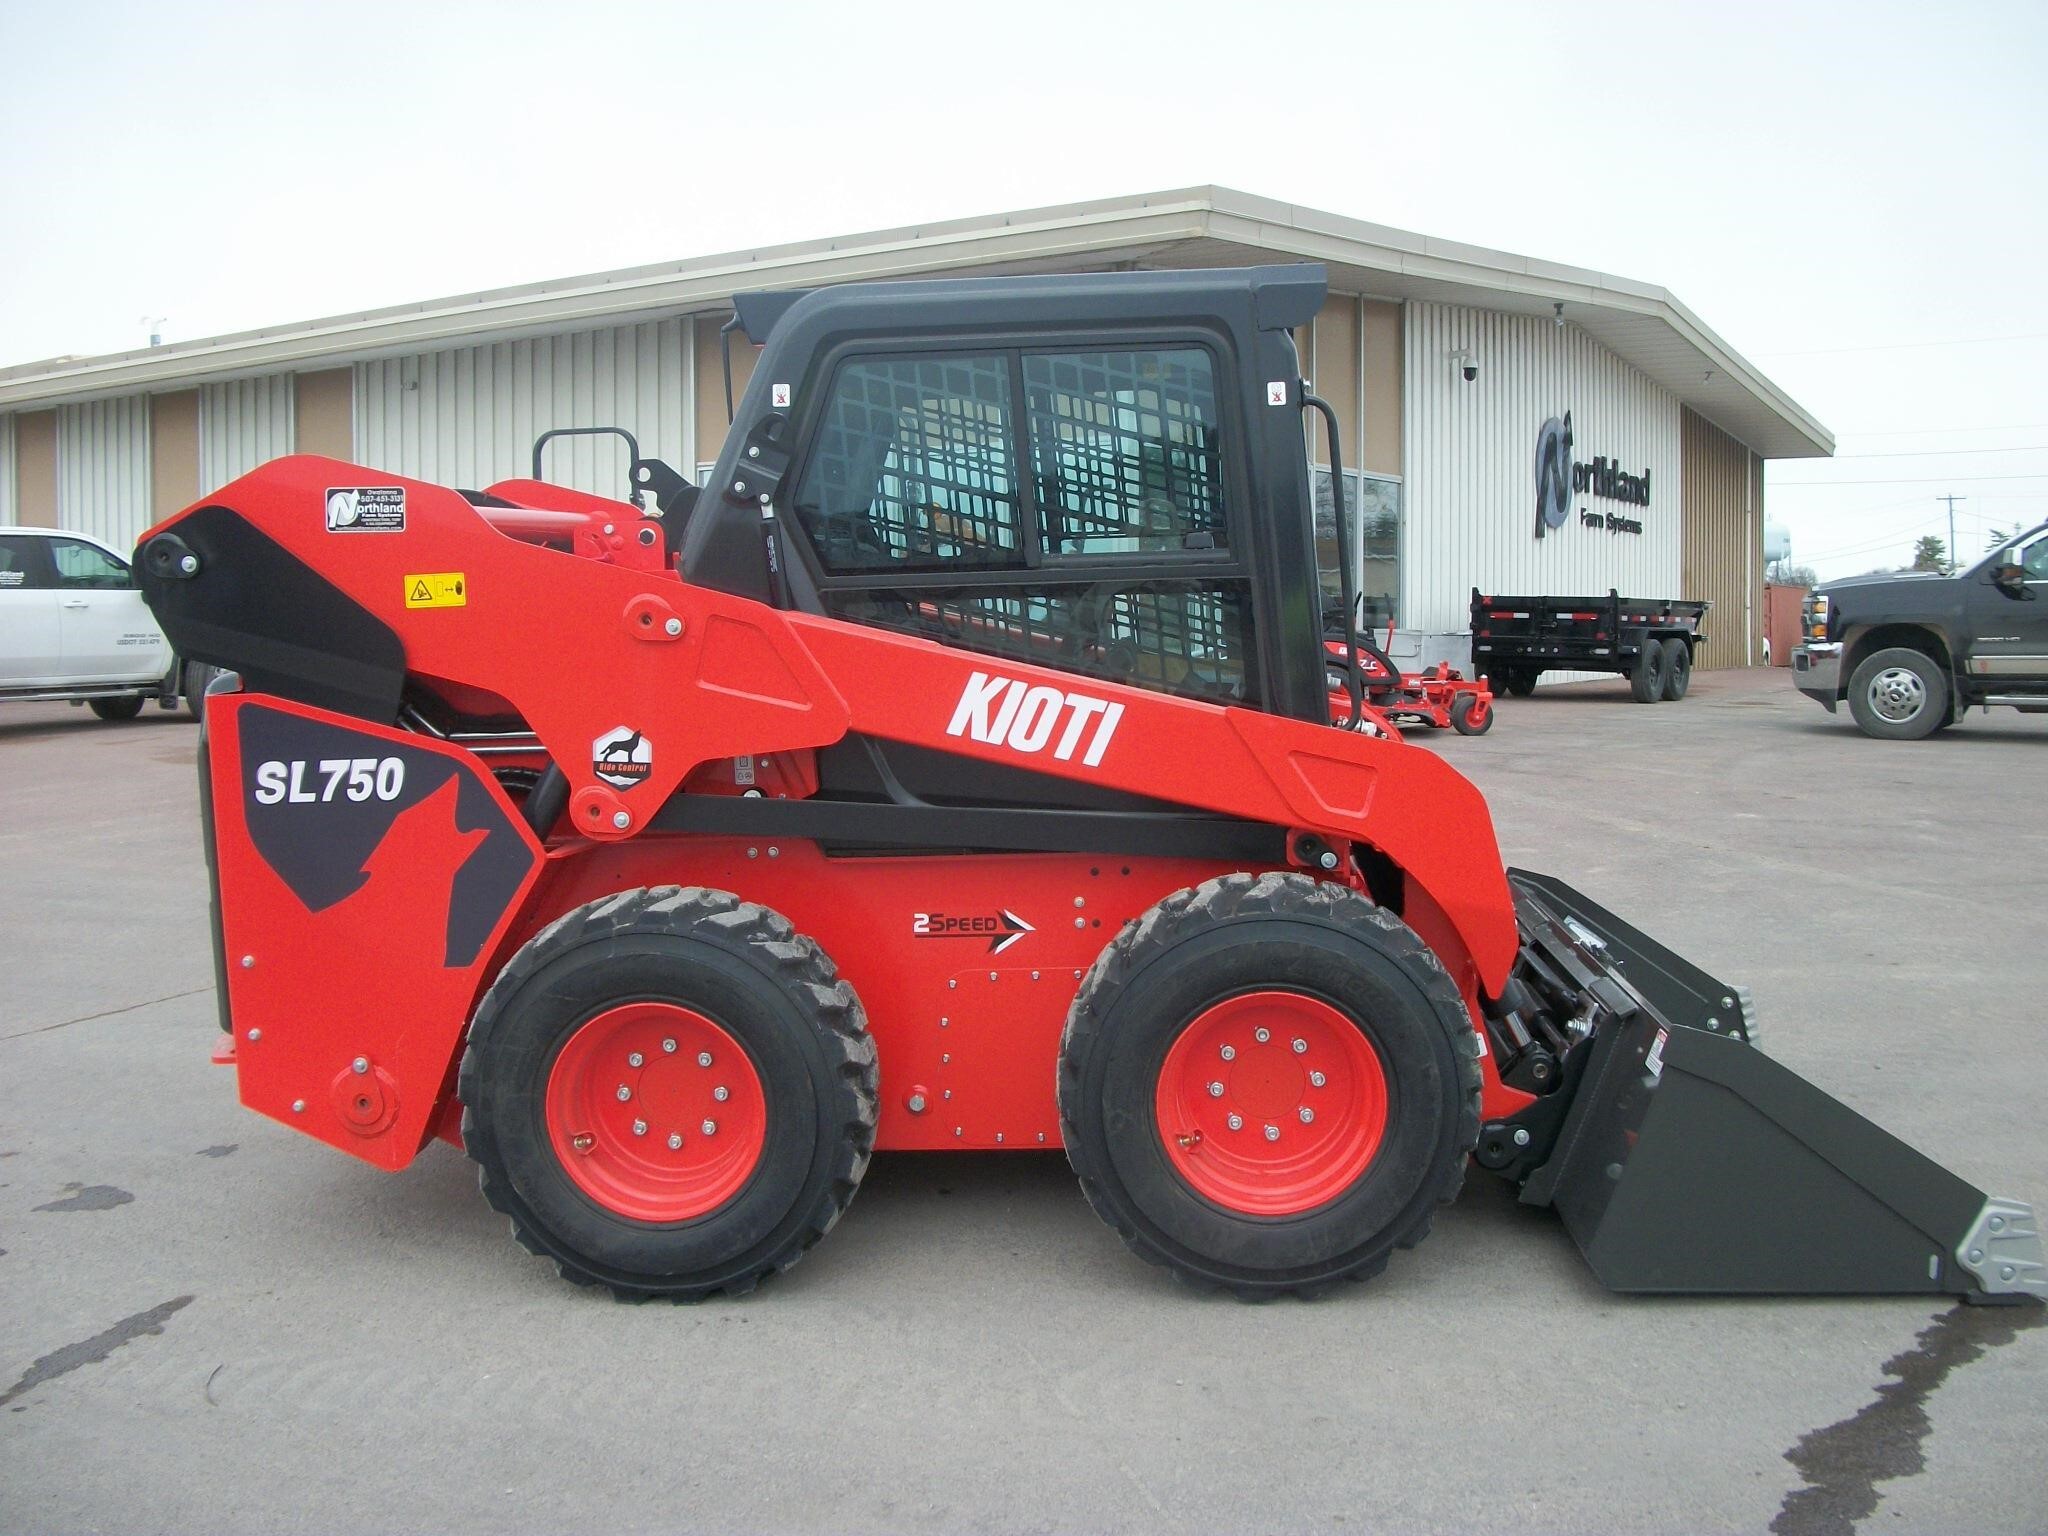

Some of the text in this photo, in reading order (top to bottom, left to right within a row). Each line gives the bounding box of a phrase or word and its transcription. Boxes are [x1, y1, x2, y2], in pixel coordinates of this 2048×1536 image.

[1535, 410, 1650, 538] Northland
[1581, 507, 1642, 535] Farm Systems
[946, 671, 1126, 767] KIOTI
[255, 757, 405, 804] SL750
[599, 762, 647, 772] Ride Control
